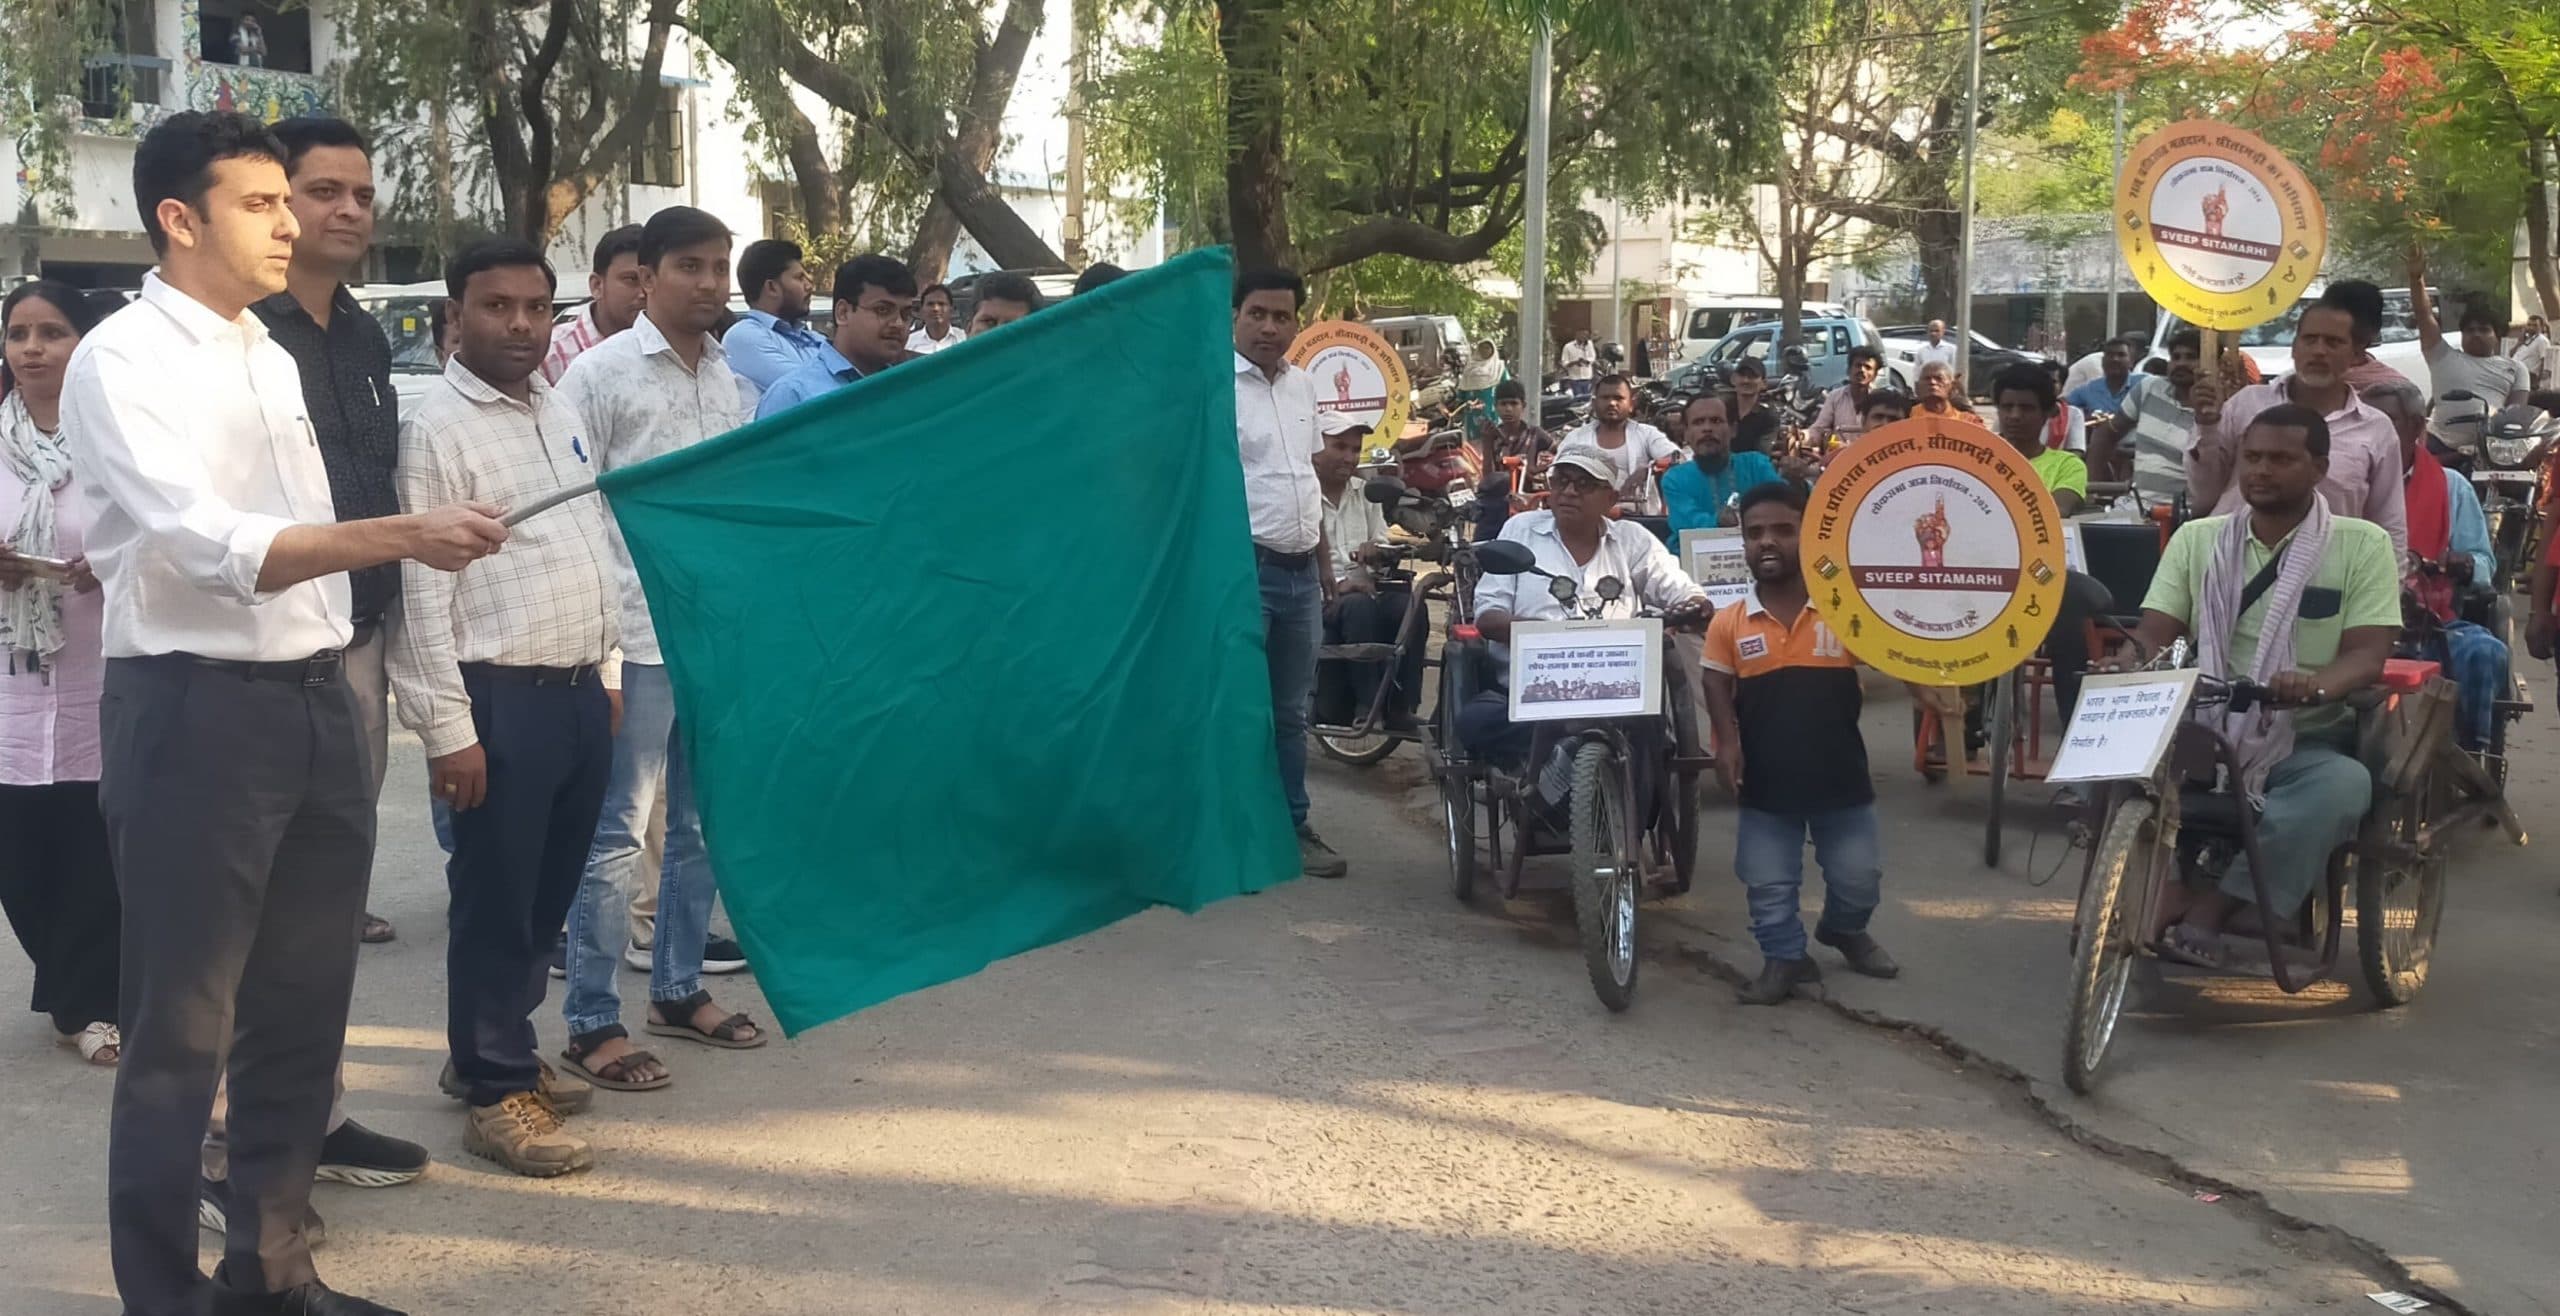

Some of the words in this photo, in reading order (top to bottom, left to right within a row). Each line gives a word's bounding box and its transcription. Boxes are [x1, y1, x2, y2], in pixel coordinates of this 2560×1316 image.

[2160, 230, 2198, 246] SVEEP
[2201, 237, 2268, 257] SITAMARHI
[1826, 463, 1867, 513] प्रतिशत
[1995, 459, 2017, 483] का
[2012, 479, 2050, 545] अभियान
[1865, 571, 1914, 583] SVEEP
[1918, 572, 2003, 585] SITAMARHI
